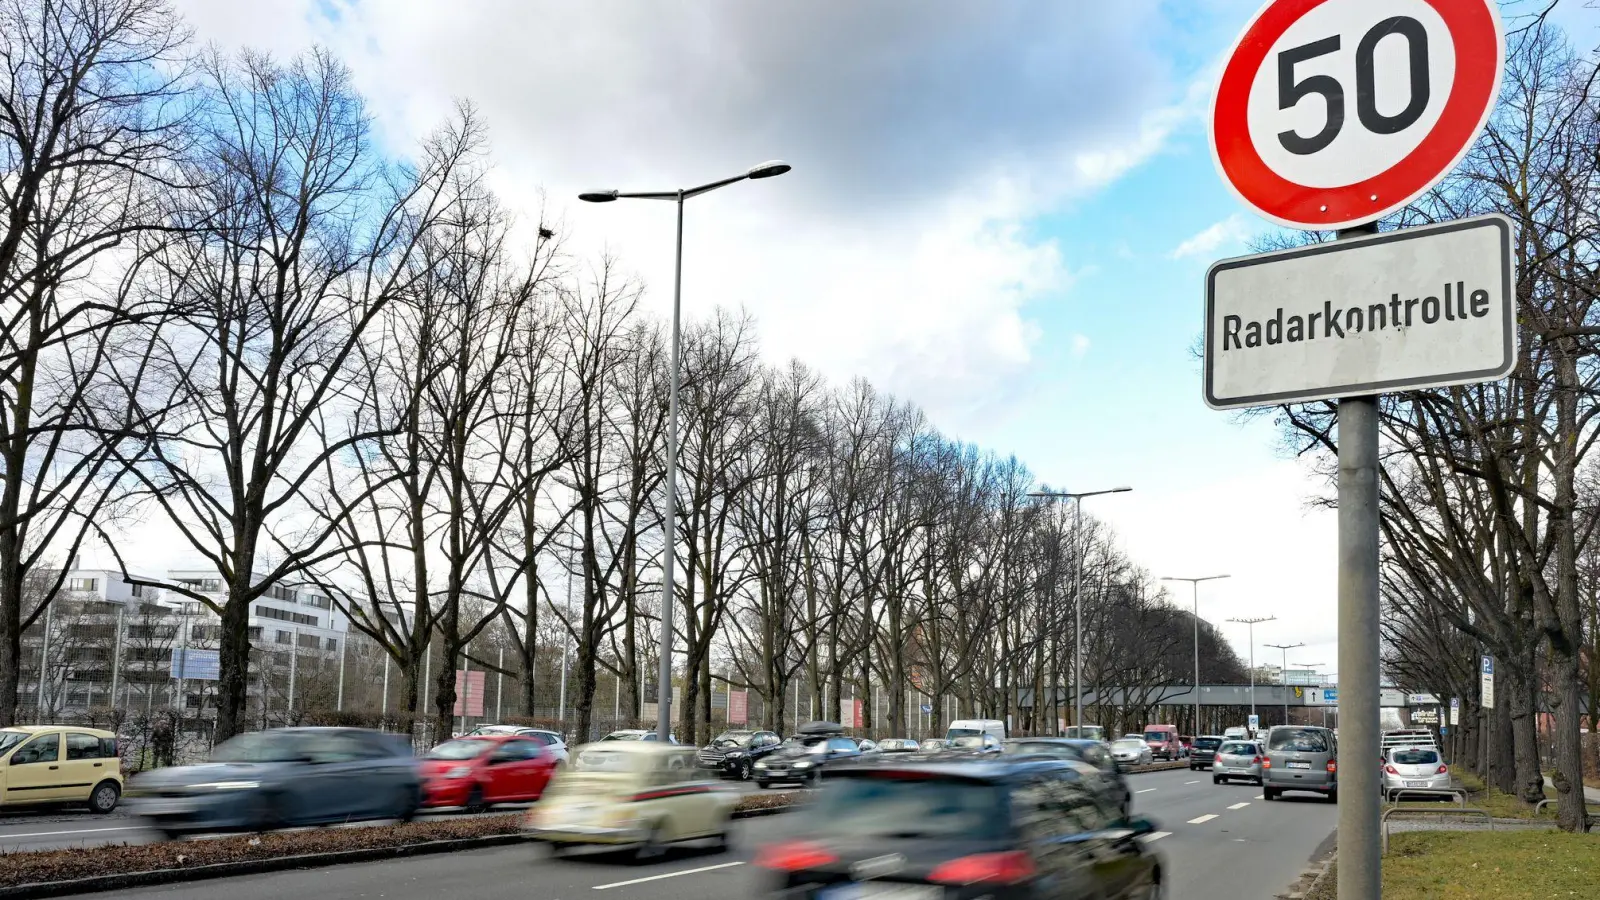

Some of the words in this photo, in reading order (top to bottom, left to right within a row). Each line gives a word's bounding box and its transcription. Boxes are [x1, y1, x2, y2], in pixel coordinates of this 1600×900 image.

[1278, 15, 1430, 155] 50
[1223, 281, 1490, 351] Radarkontrolle
[1483, 658, 1490, 671] P
